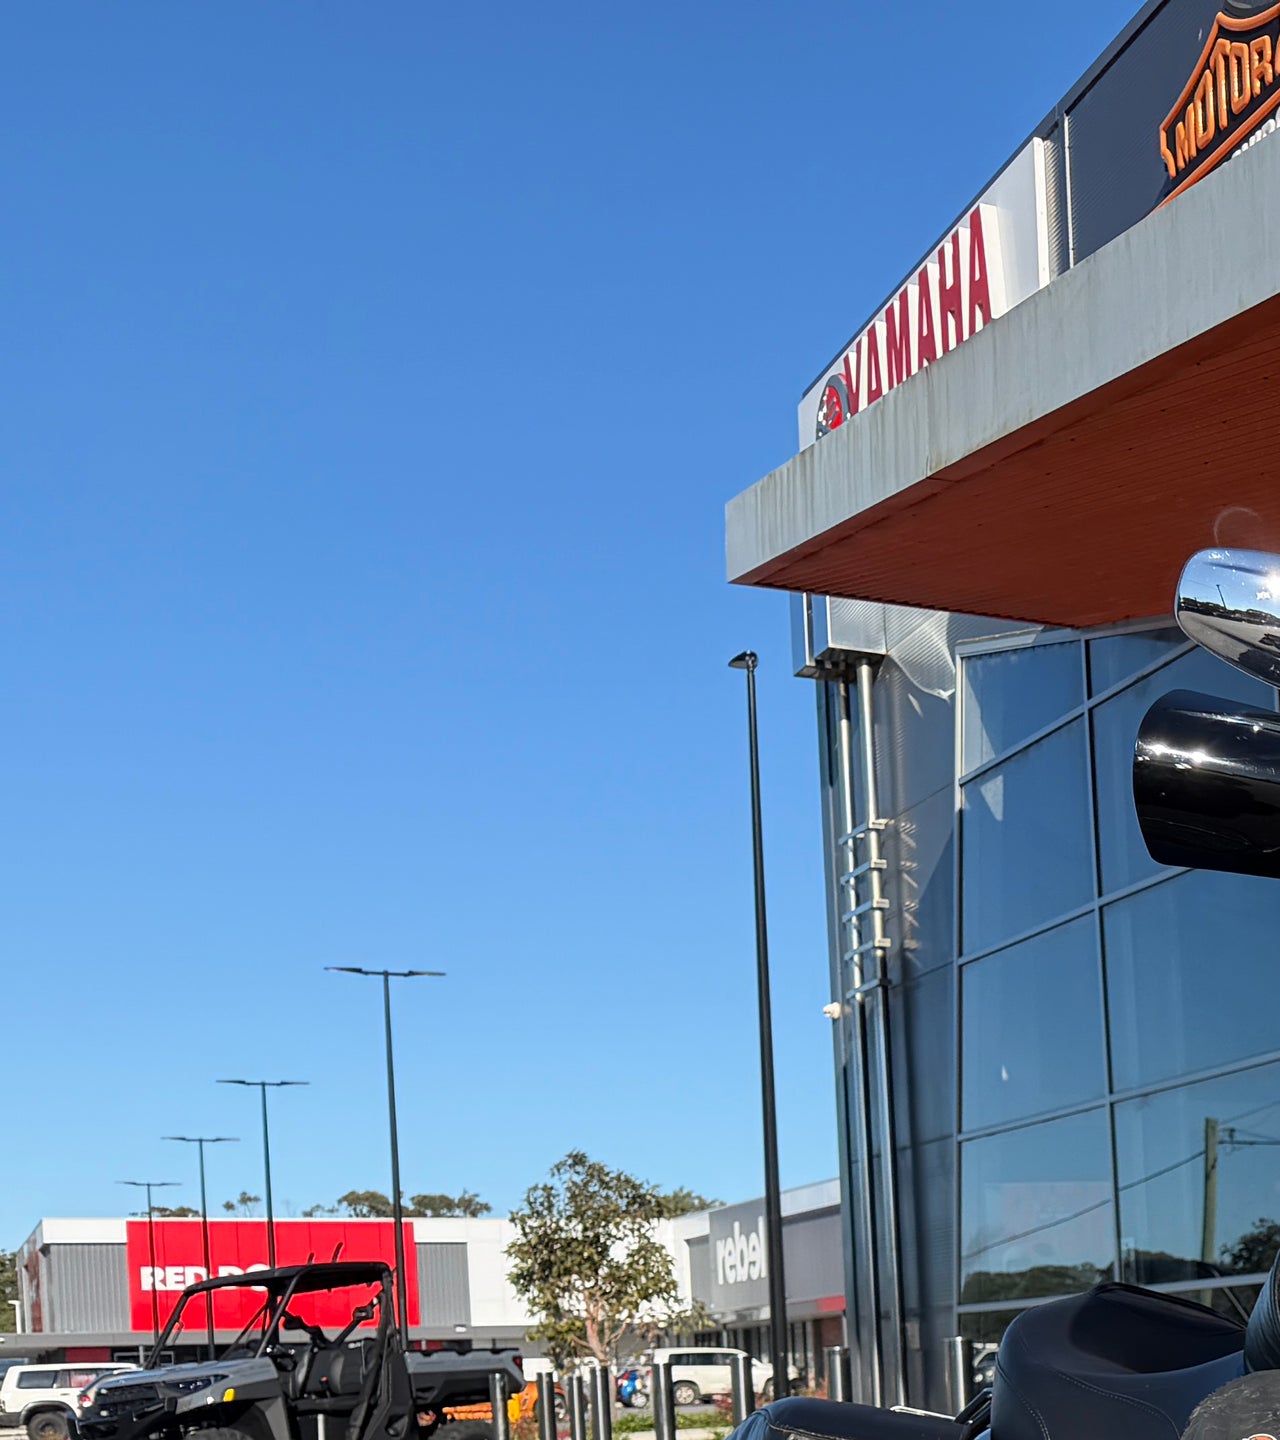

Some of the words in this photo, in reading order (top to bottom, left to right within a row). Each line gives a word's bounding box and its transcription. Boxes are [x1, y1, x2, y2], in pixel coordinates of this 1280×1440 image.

[1175, 35, 1274, 169] MOTOR
[843, 204, 993, 418] YAMAHA
[140, 1265, 208, 1291] RED
[716, 1216, 767, 1285] rebel
